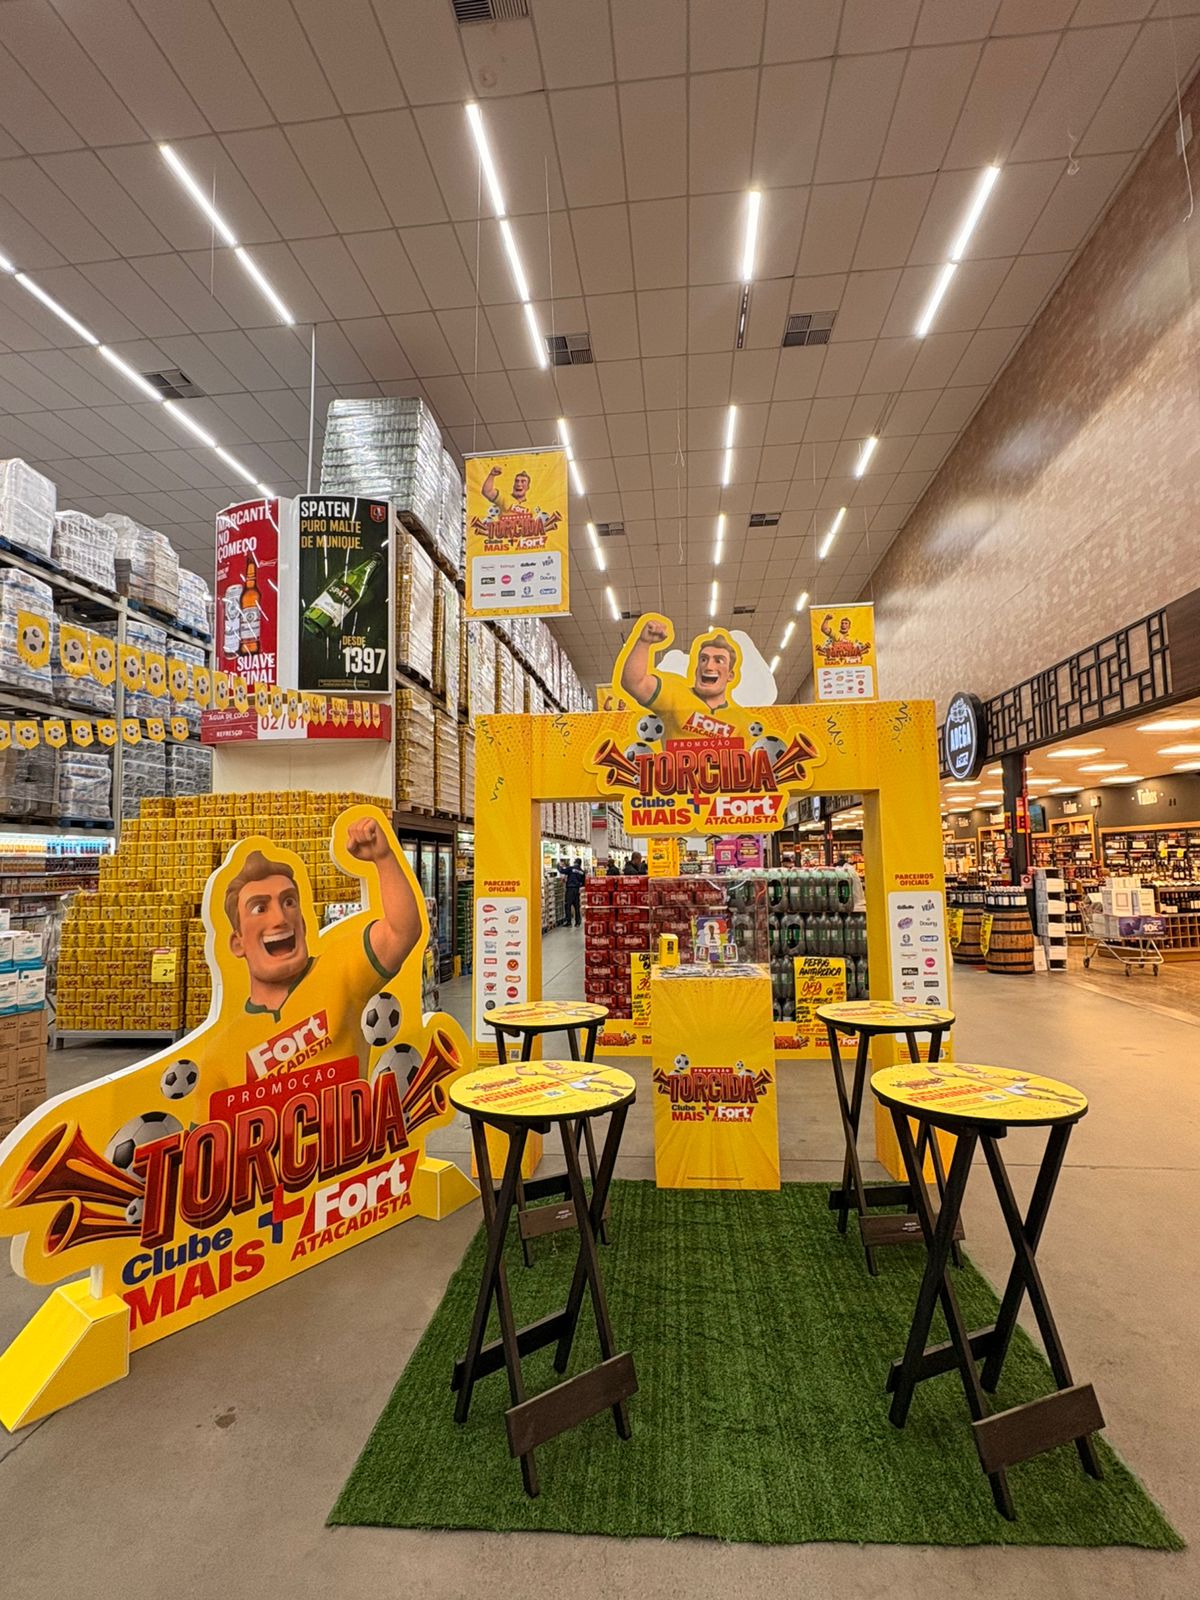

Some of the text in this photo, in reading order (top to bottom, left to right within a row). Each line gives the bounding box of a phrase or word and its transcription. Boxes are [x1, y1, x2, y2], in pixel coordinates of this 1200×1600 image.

[301, 501, 350, 517] SPATEN
[217, 506, 272, 531] MARCANTE
[301, 519, 361, 533] PURO MALTE
[218, 530, 230, 546] NO
[301, 535, 364, 550] DE MUNIQUE.
[520, 536, 545, 548] Fort
[484, 544, 510, 552] MAIS
[342, 635, 366, 646] DESDE
[237, 653, 275, 671] SUAVE
[342, 646, 386, 674] 1397
[240, 669, 275, 686] FINAL
[692, 712, 731, 738] Fort
[673, 740, 730, 748] PROMOÇÃO
[635, 747, 778, 796] TORCIDA
[631, 795, 776, 817] Clube Fort
[631, 808, 779, 825] MAIS ATACADISTA
[247, 1016, 327, 1080] Fort
[227, 1067, 336, 1107] PROMOÇÃO
[668, 1073, 758, 1103] TORCIDA
[671, 1111, 704, 1121] MAIS
[717, 1106, 750, 1118] Fort
[134, 1071, 409, 1249] TORCIDA
[121, 1157, 408, 1285] Clube Fort
[122, 1191, 412, 1331] MAIS ATACADISTA
